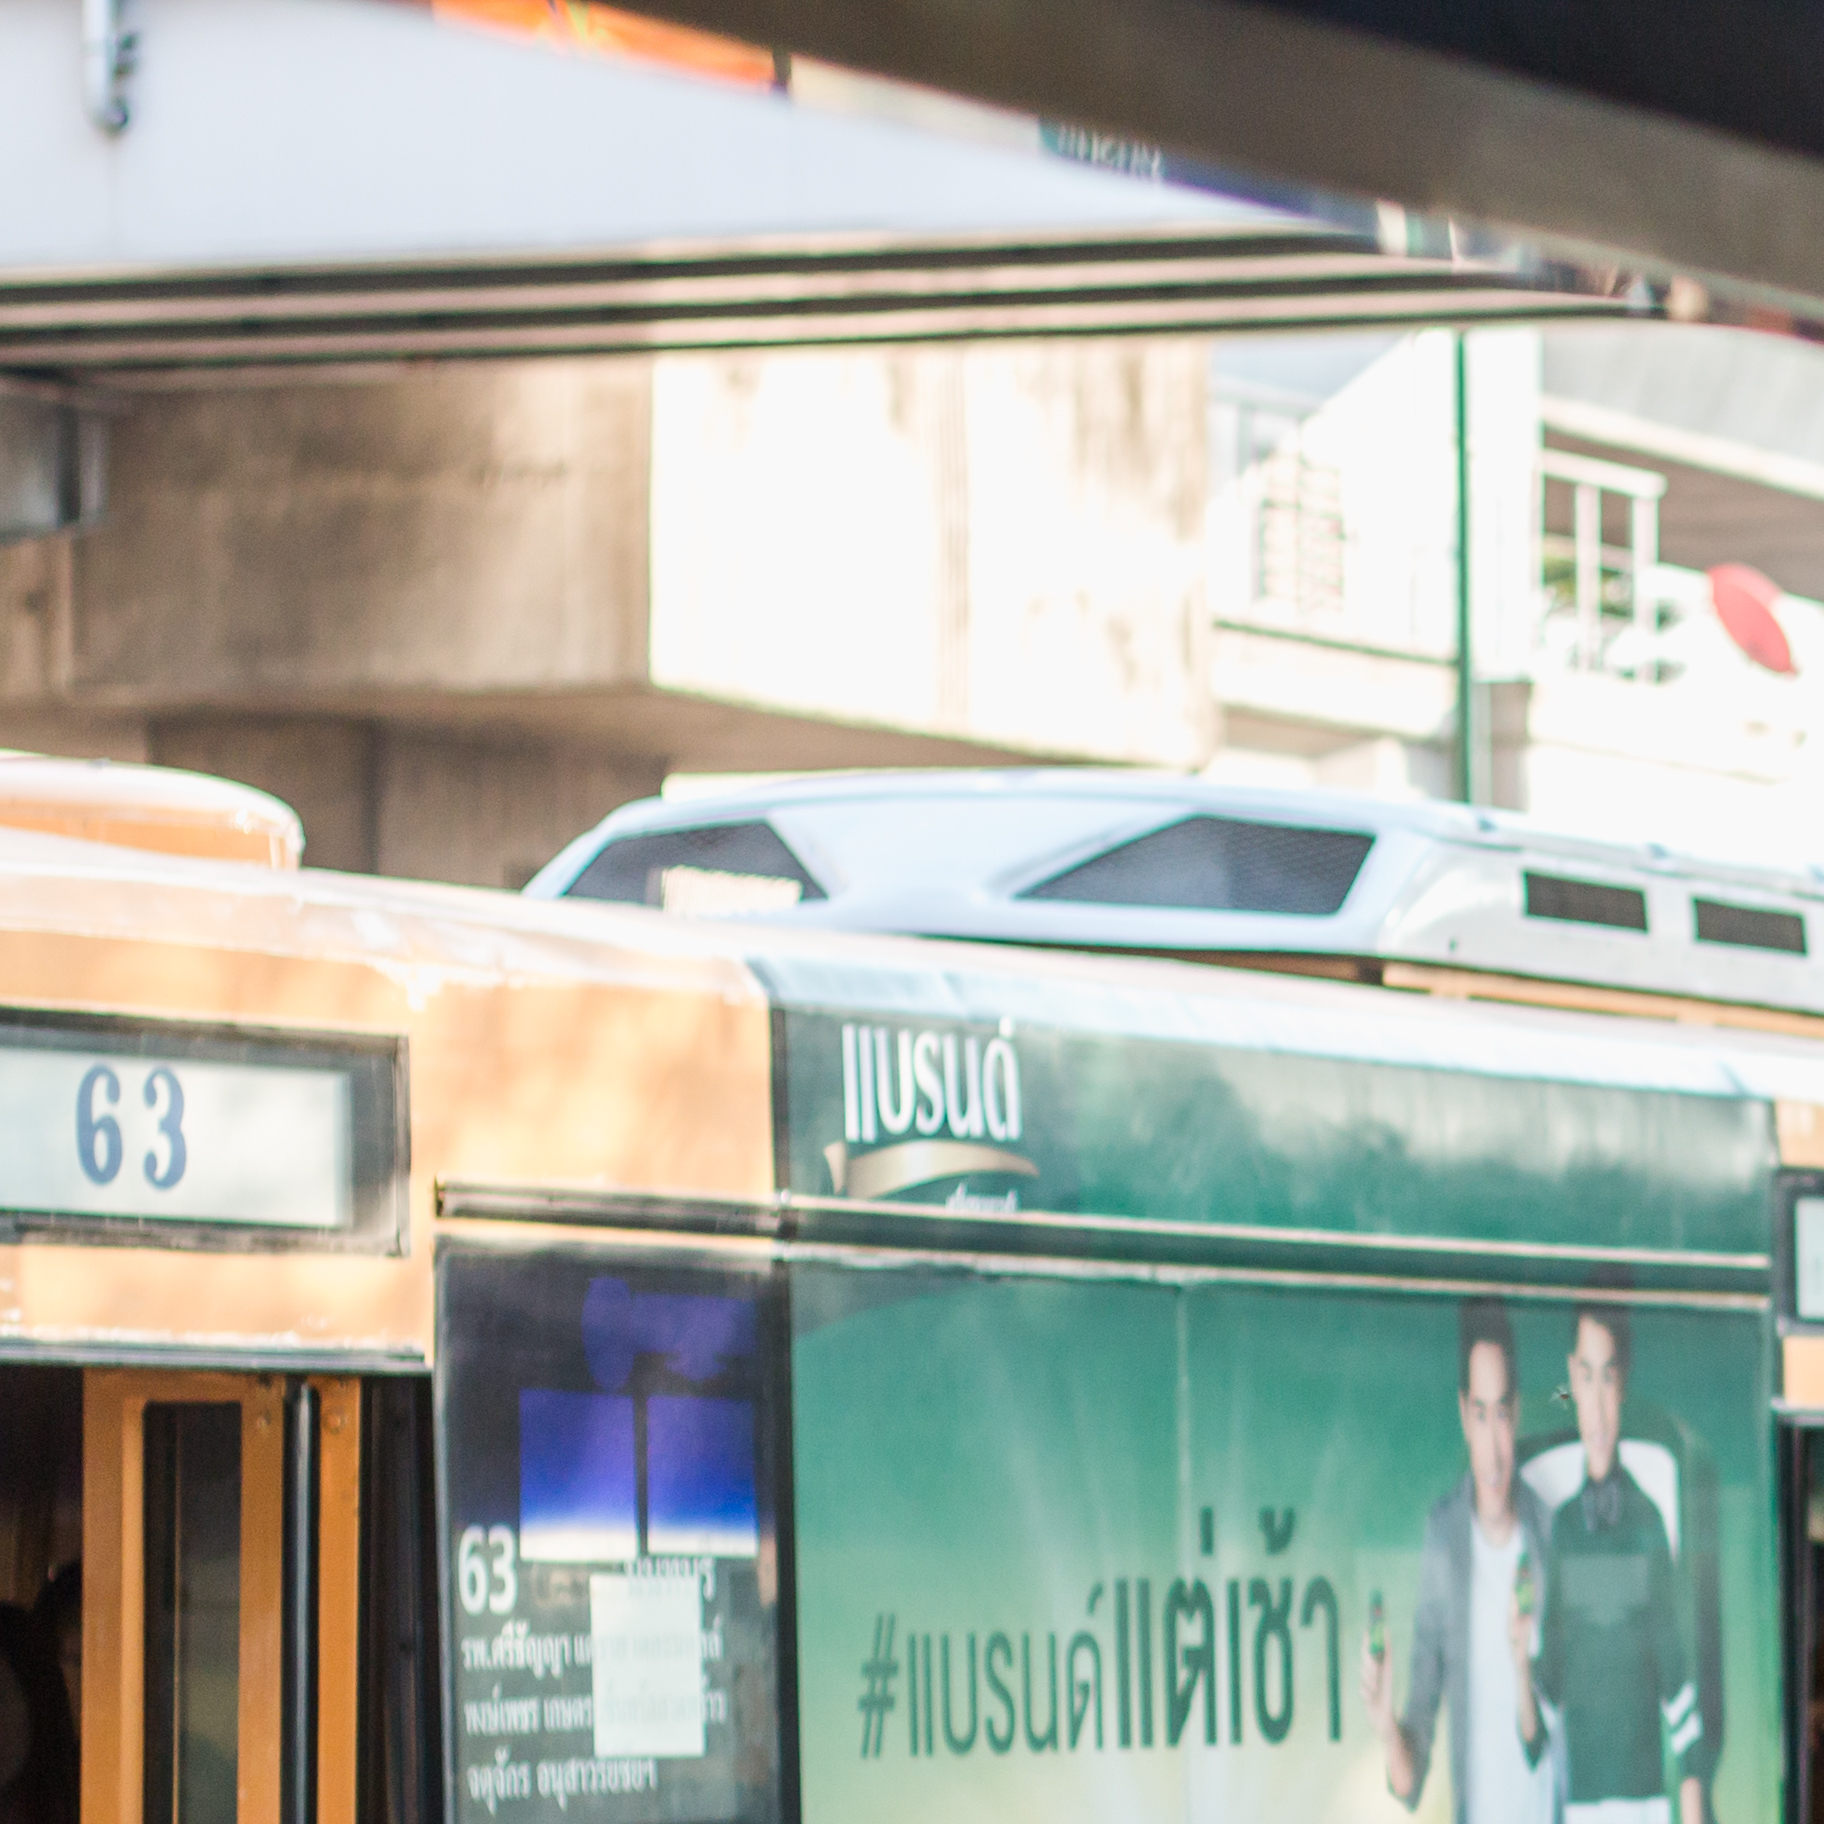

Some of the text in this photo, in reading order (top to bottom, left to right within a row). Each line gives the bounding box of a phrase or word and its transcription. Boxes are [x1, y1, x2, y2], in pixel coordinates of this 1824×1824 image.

[75, 1064, 188, 1191] 63
[841, 1017, 1026, 1142] แบรนด์
[458, 1524, 518, 1616] 63
